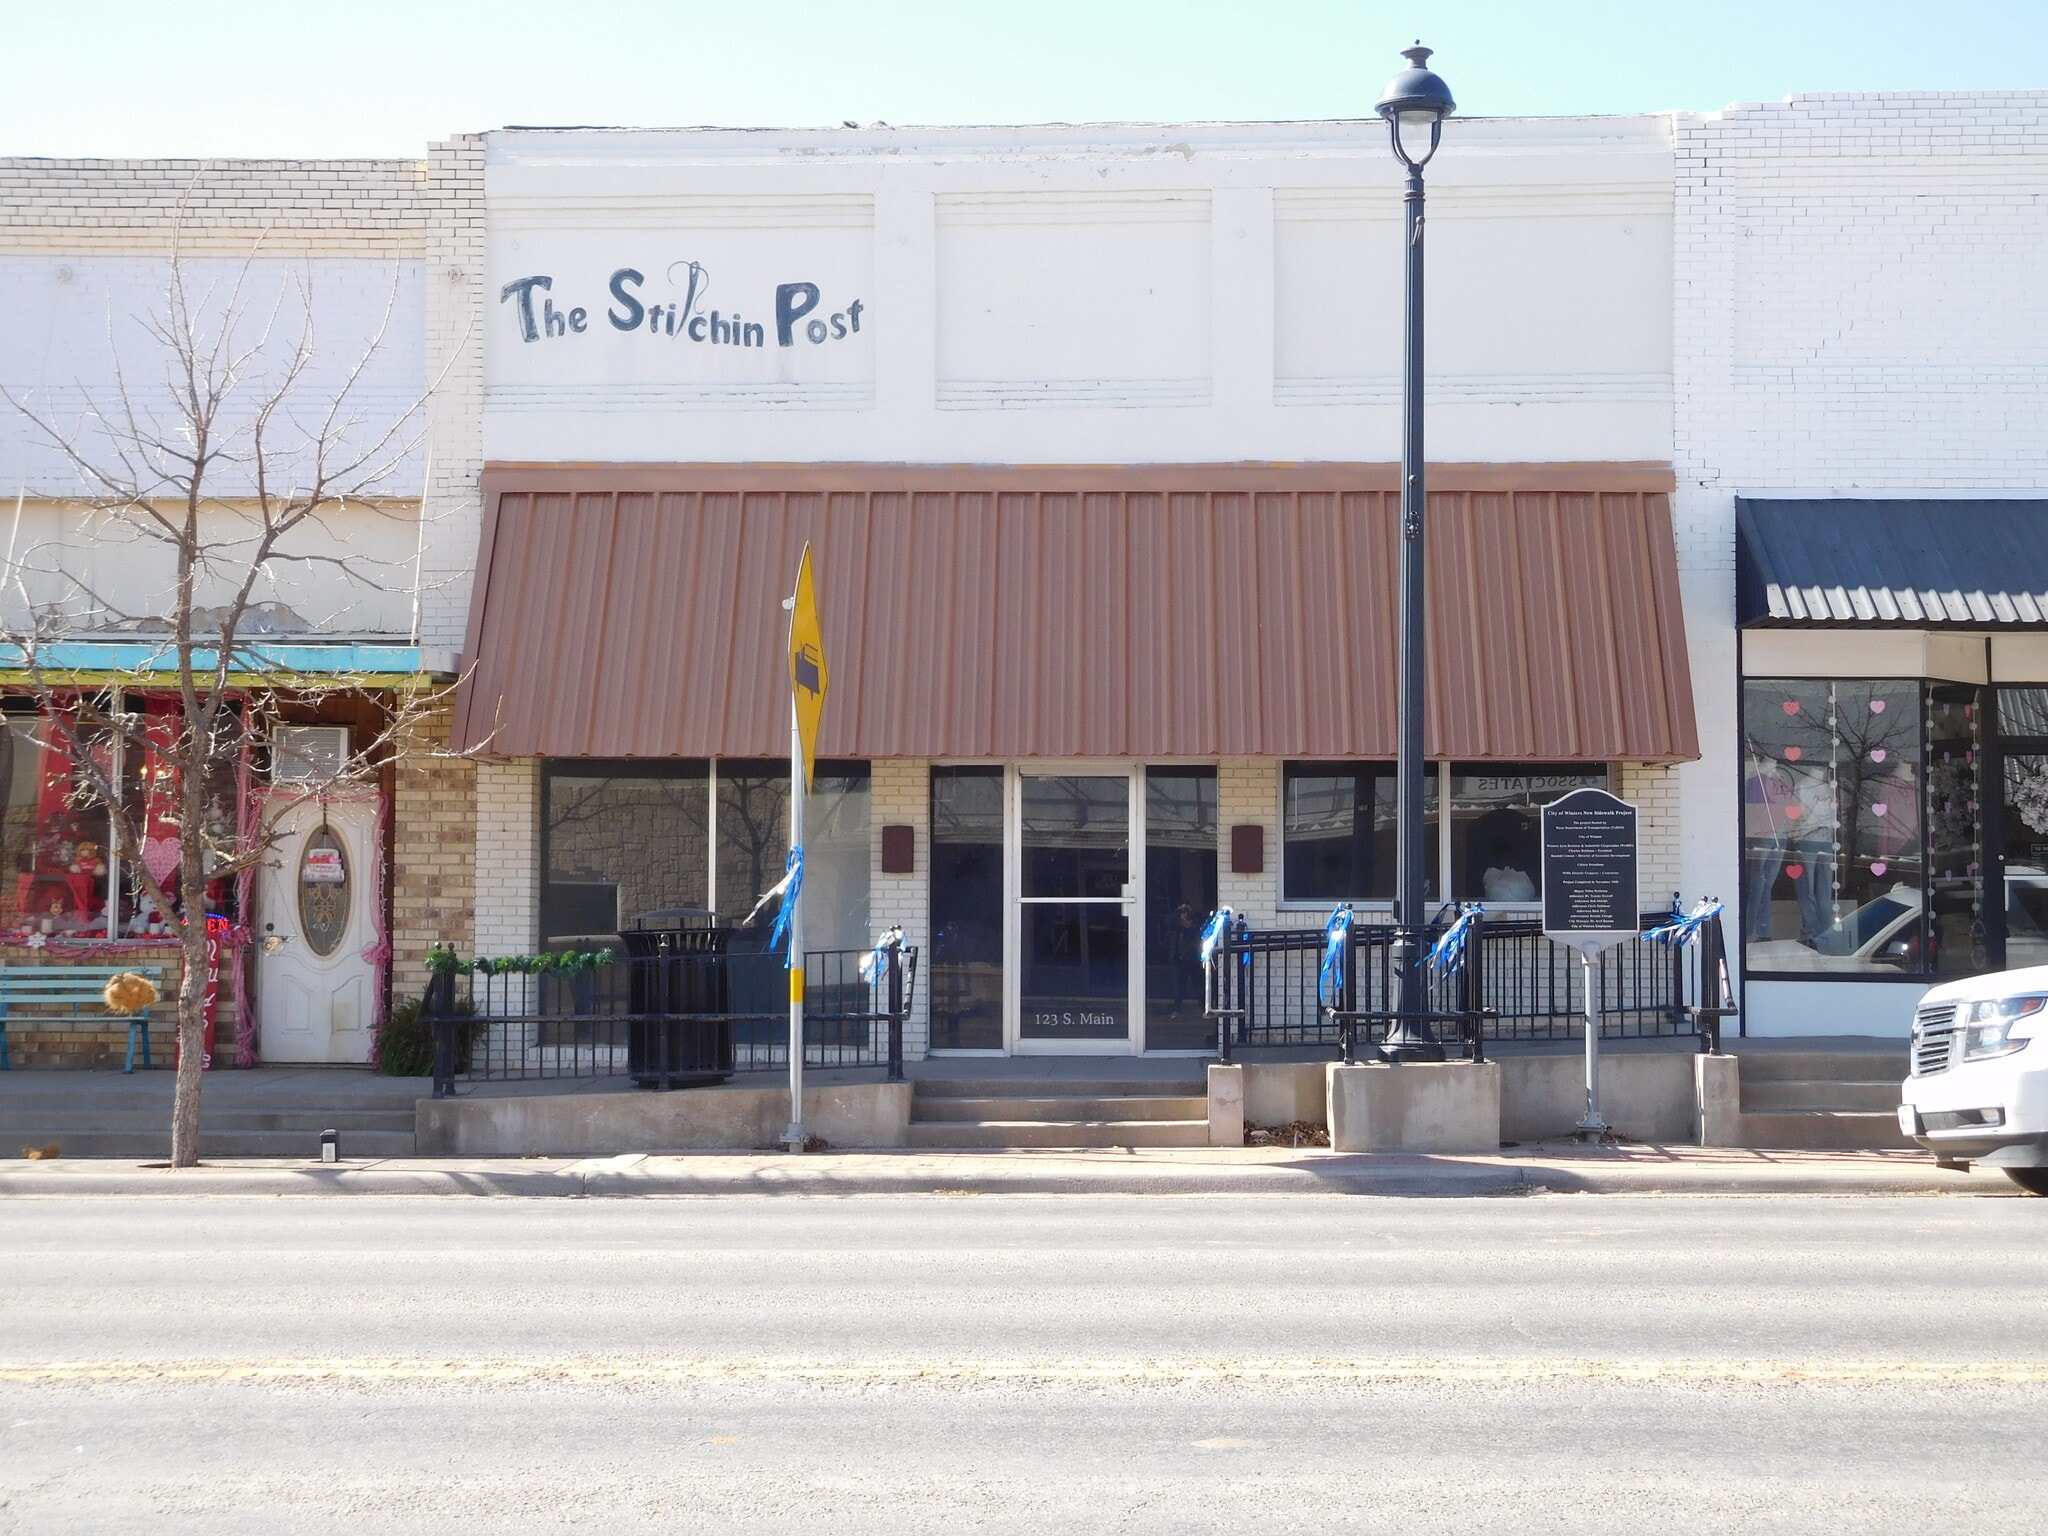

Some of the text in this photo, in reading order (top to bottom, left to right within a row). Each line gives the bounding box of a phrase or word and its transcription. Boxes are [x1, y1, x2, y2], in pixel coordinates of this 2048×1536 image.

[500, 275, 588, 343] The
[776, 281, 864, 347] Post
[1035, 1013, 1114, 1026] 123 S. Main
